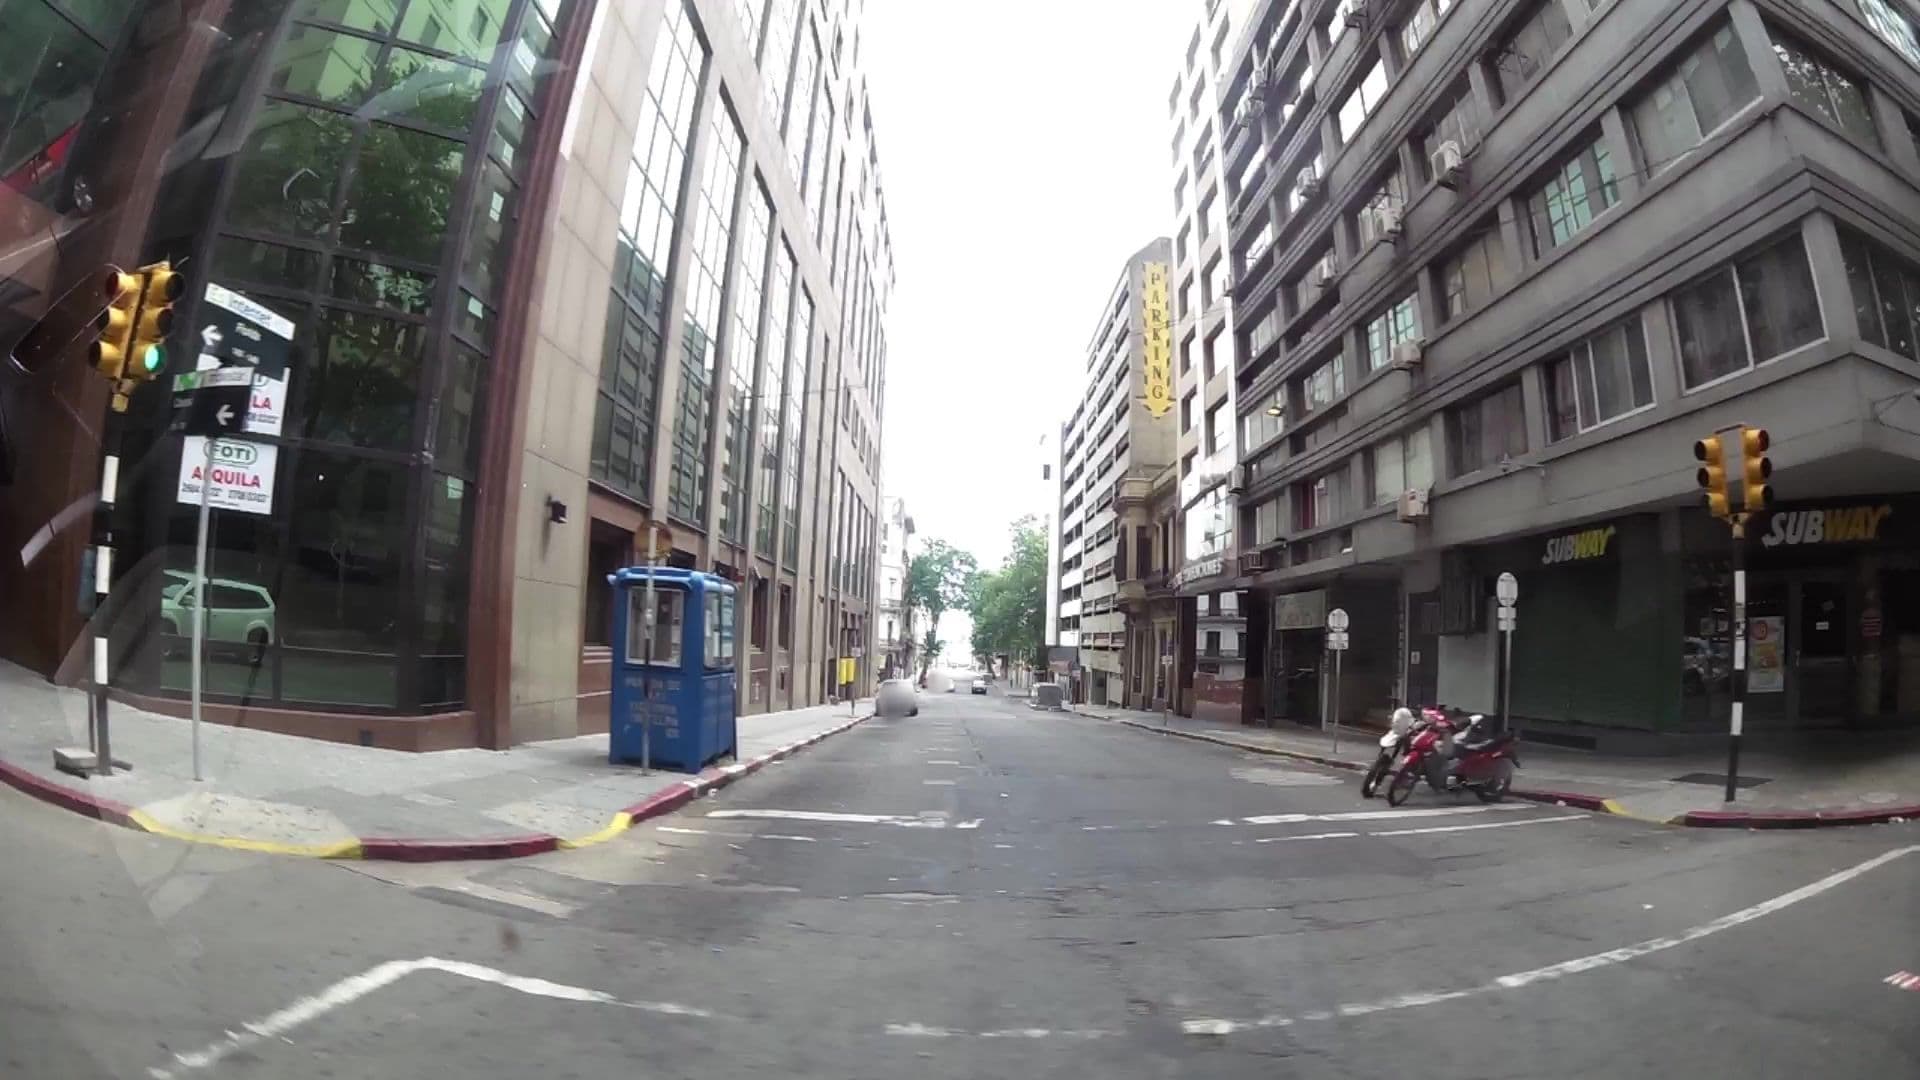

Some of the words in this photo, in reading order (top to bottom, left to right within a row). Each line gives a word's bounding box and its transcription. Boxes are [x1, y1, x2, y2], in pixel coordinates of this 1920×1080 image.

[1151, 272, 1163, 400] PARKING
[191, 466, 261, 489] AQUILA
[1542, 525, 1616, 565] SUBWAY
[1761, 504, 1892, 549] SUBWAY
